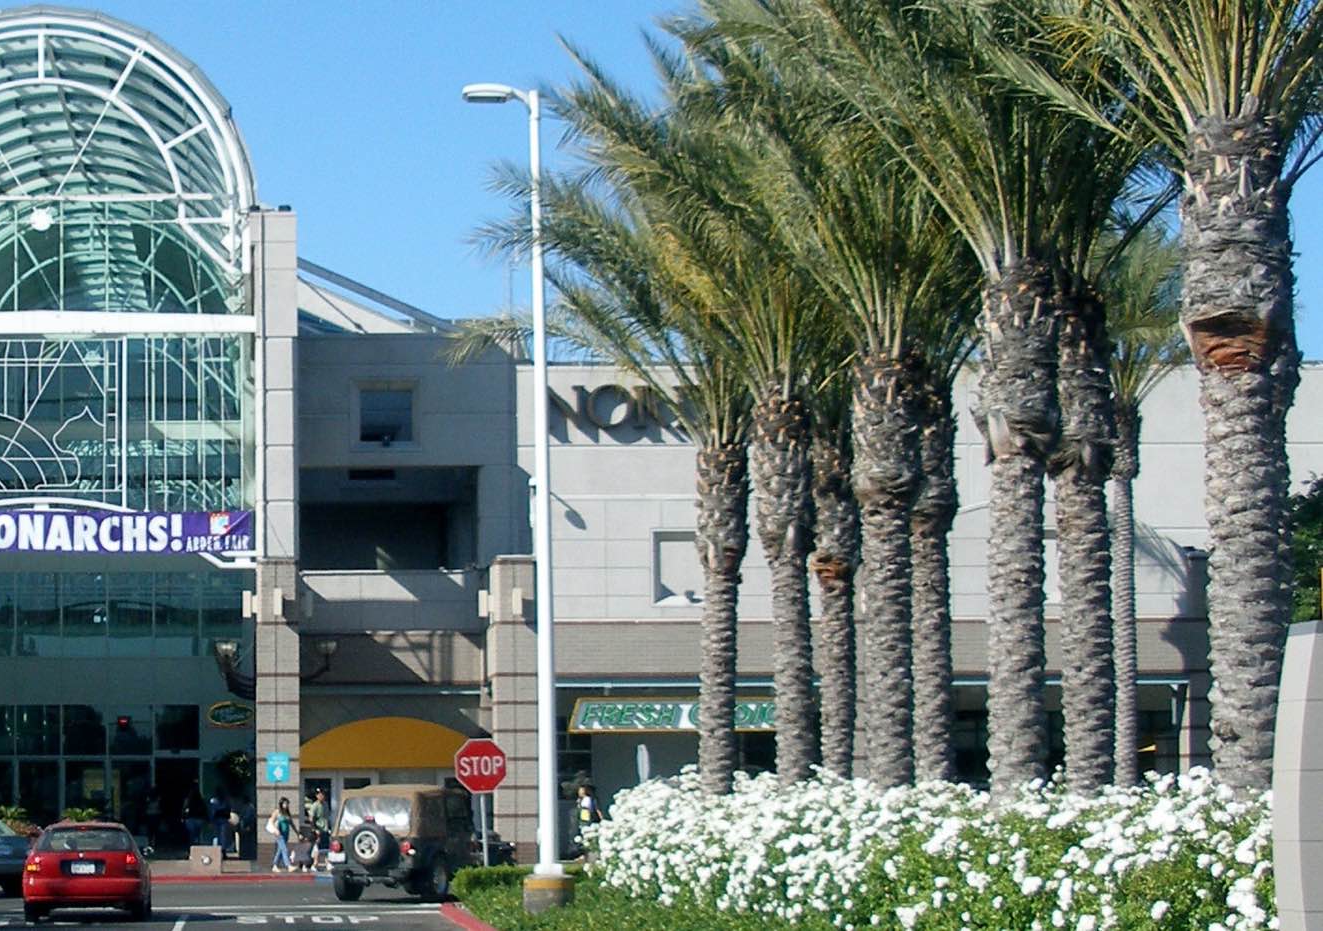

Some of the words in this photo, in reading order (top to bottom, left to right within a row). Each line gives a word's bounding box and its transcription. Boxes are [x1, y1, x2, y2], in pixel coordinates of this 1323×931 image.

[582, 702, 678, 727] FRESH
[459, 755, 504, 777] STOP
[236, 915, 380, 924] STOP
